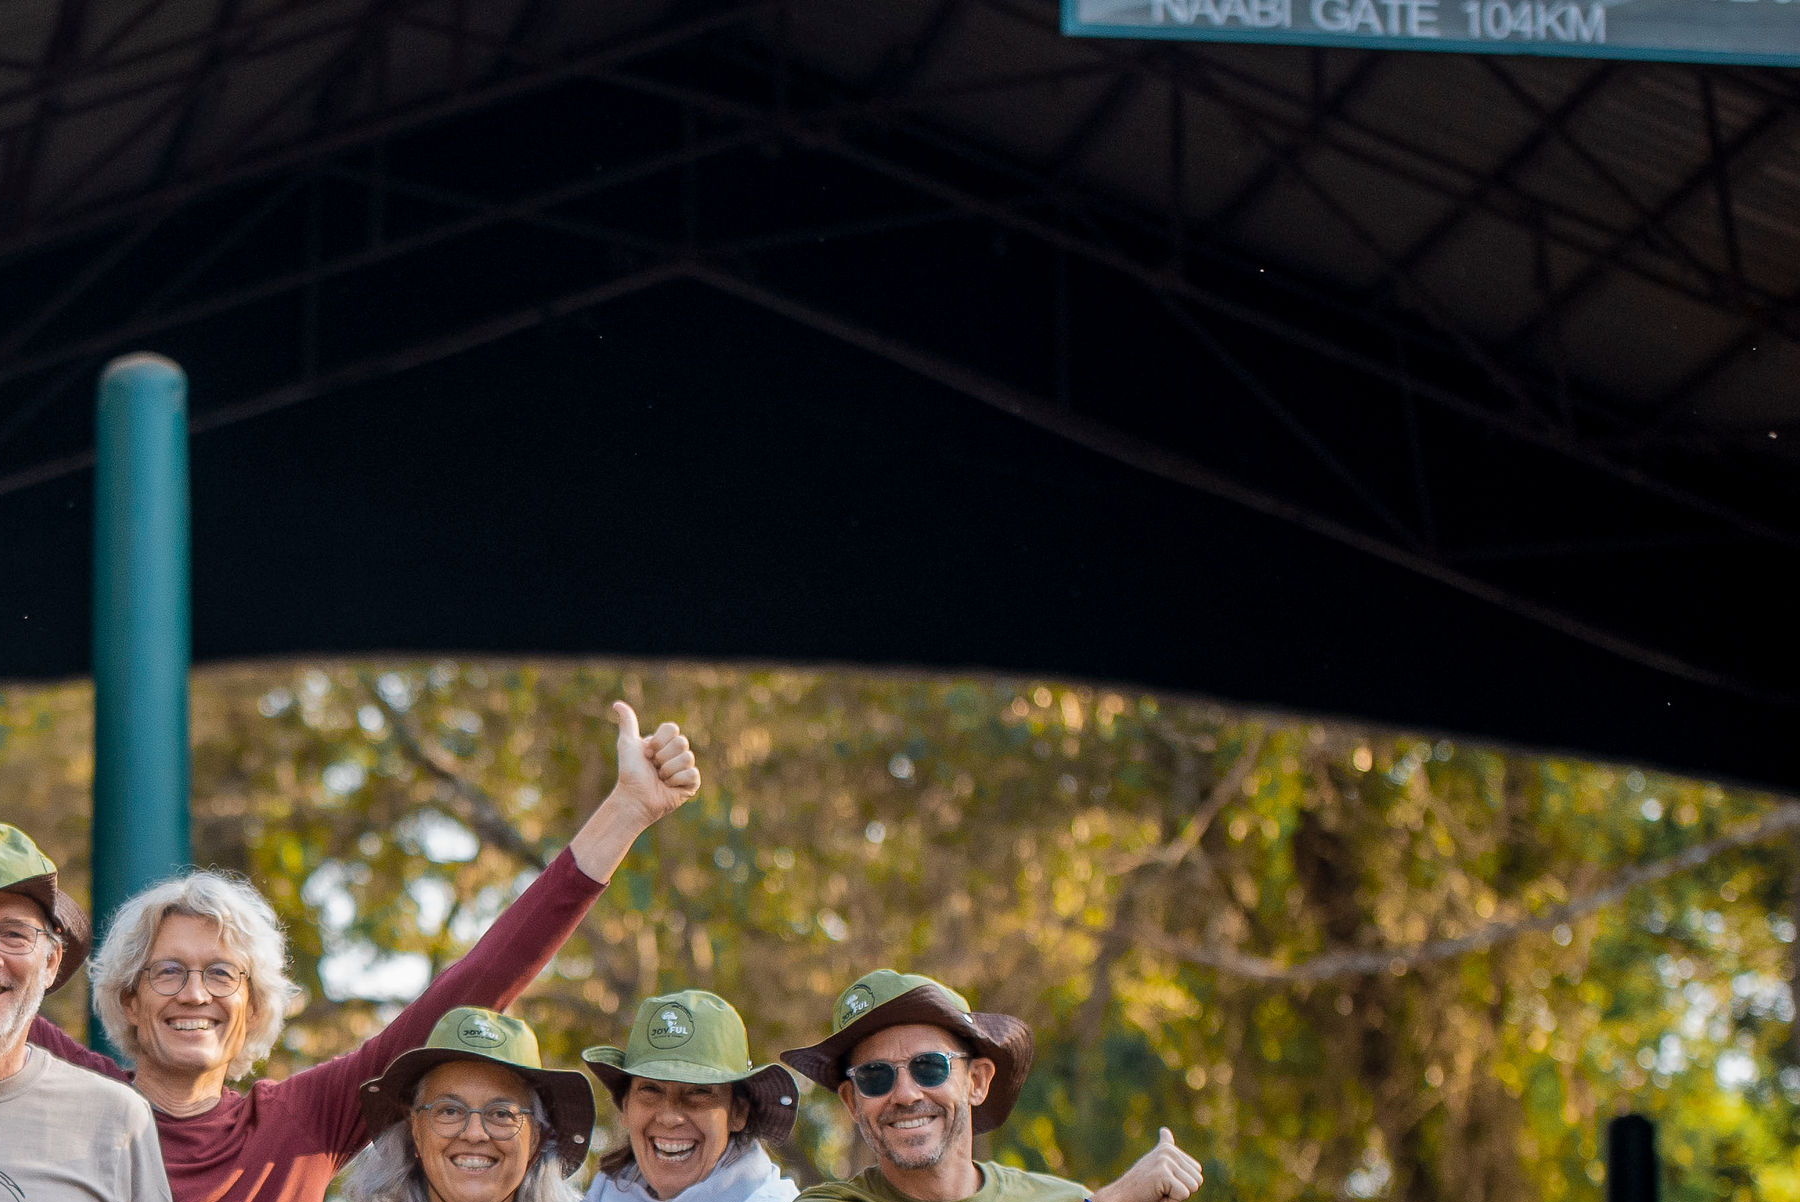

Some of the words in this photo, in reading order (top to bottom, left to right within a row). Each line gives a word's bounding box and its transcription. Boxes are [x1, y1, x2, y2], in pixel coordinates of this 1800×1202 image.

[1153, 0, 1292, 28] NAABI
[1311, 0, 1440, 37] GATE
[1465, 1, 1606, 43] 104KM
